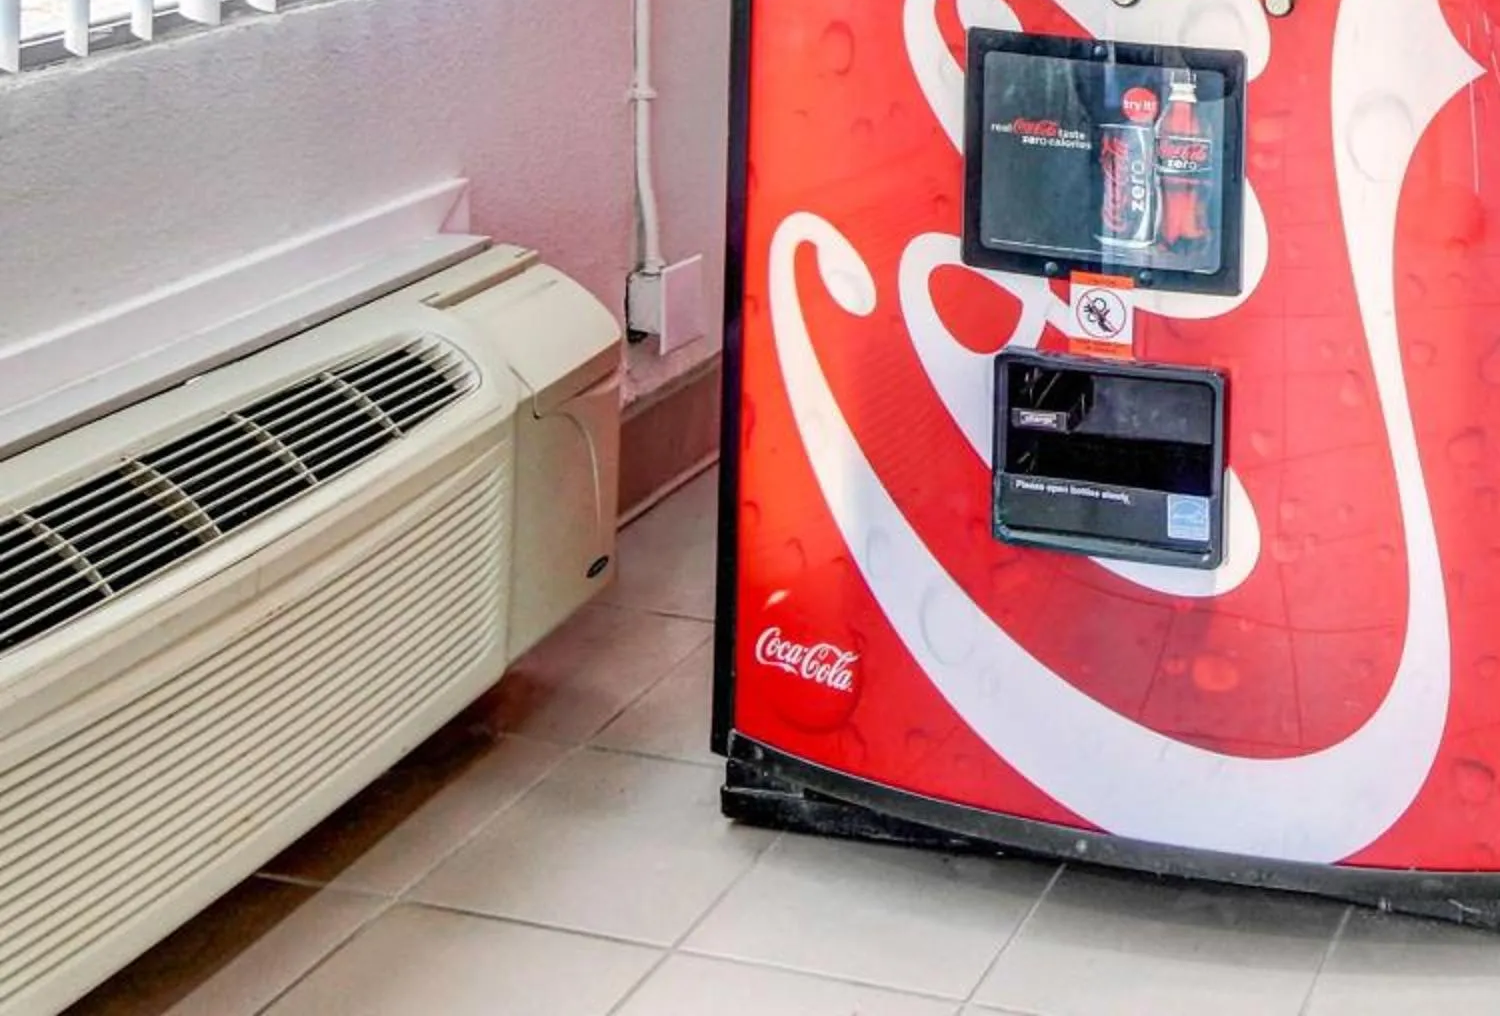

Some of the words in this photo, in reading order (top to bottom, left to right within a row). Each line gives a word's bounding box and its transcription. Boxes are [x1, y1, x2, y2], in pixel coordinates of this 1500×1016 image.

[1166, 157, 1199, 171] zero
[1130, 159, 1146, 212] zero
[1015, 479, 1045, 491] Please
[754, 626, 860, 693] Coca-Cola
